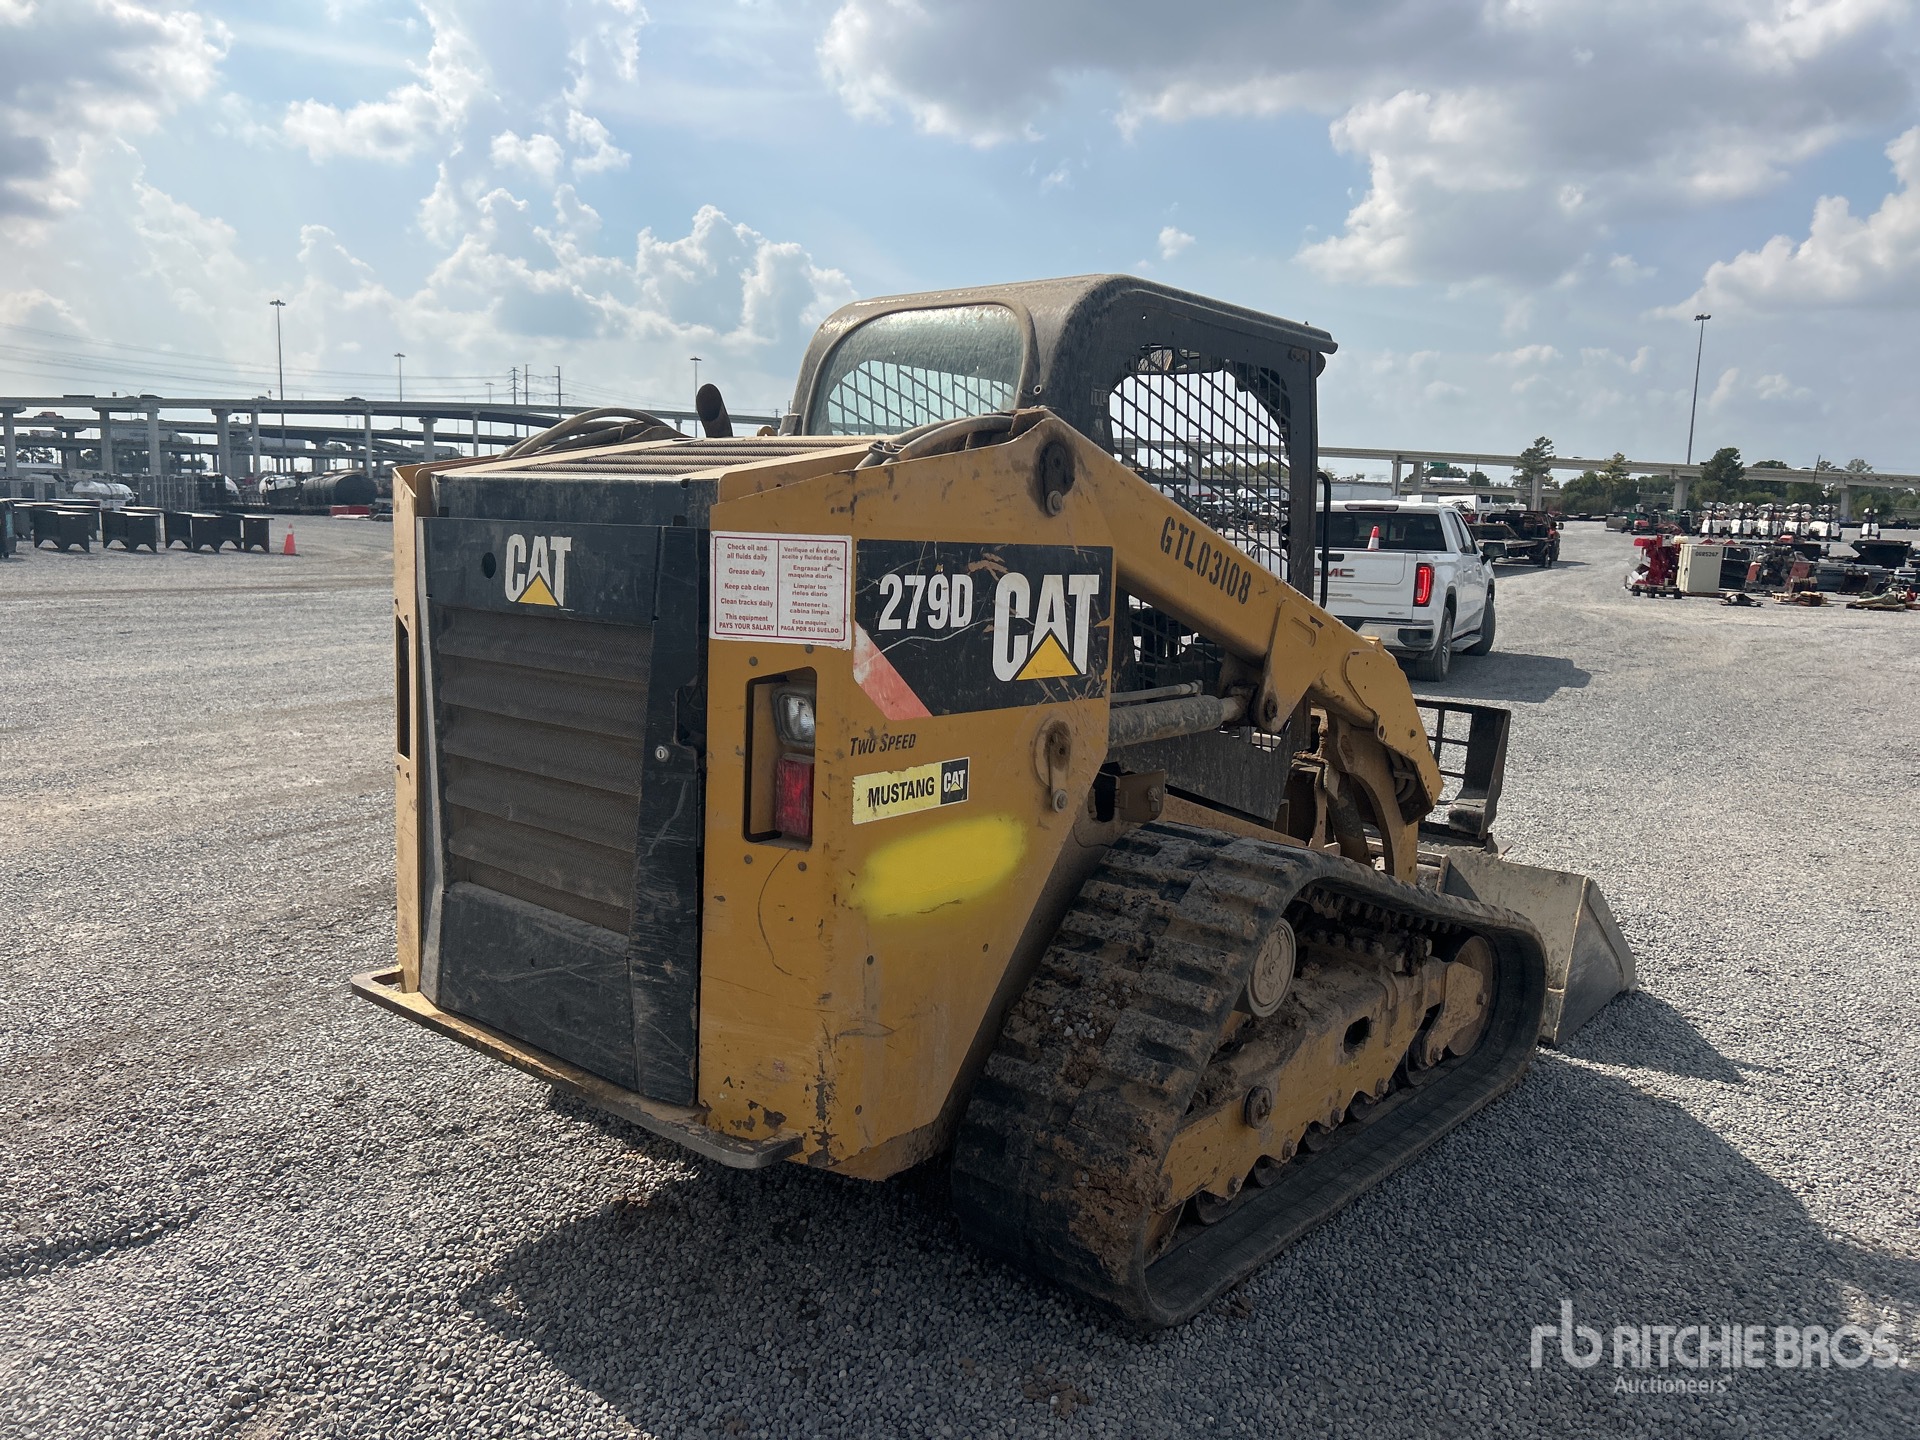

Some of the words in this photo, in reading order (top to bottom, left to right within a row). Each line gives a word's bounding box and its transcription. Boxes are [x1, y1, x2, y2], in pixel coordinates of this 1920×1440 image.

[753, 554, 767, 562] daily
[505, 533, 572, 607] CAT
[728, 567, 750, 575] Grease
[751, 569, 765, 577] daily
[759, 600, 773, 608] daily
[739, 614, 768, 622] equipment
[878, 573, 973, 630] 279D
[992, 572, 1100, 682] CAT
[867, 776, 935, 808] MUSTANG
[943, 769, 966, 793] CAT
